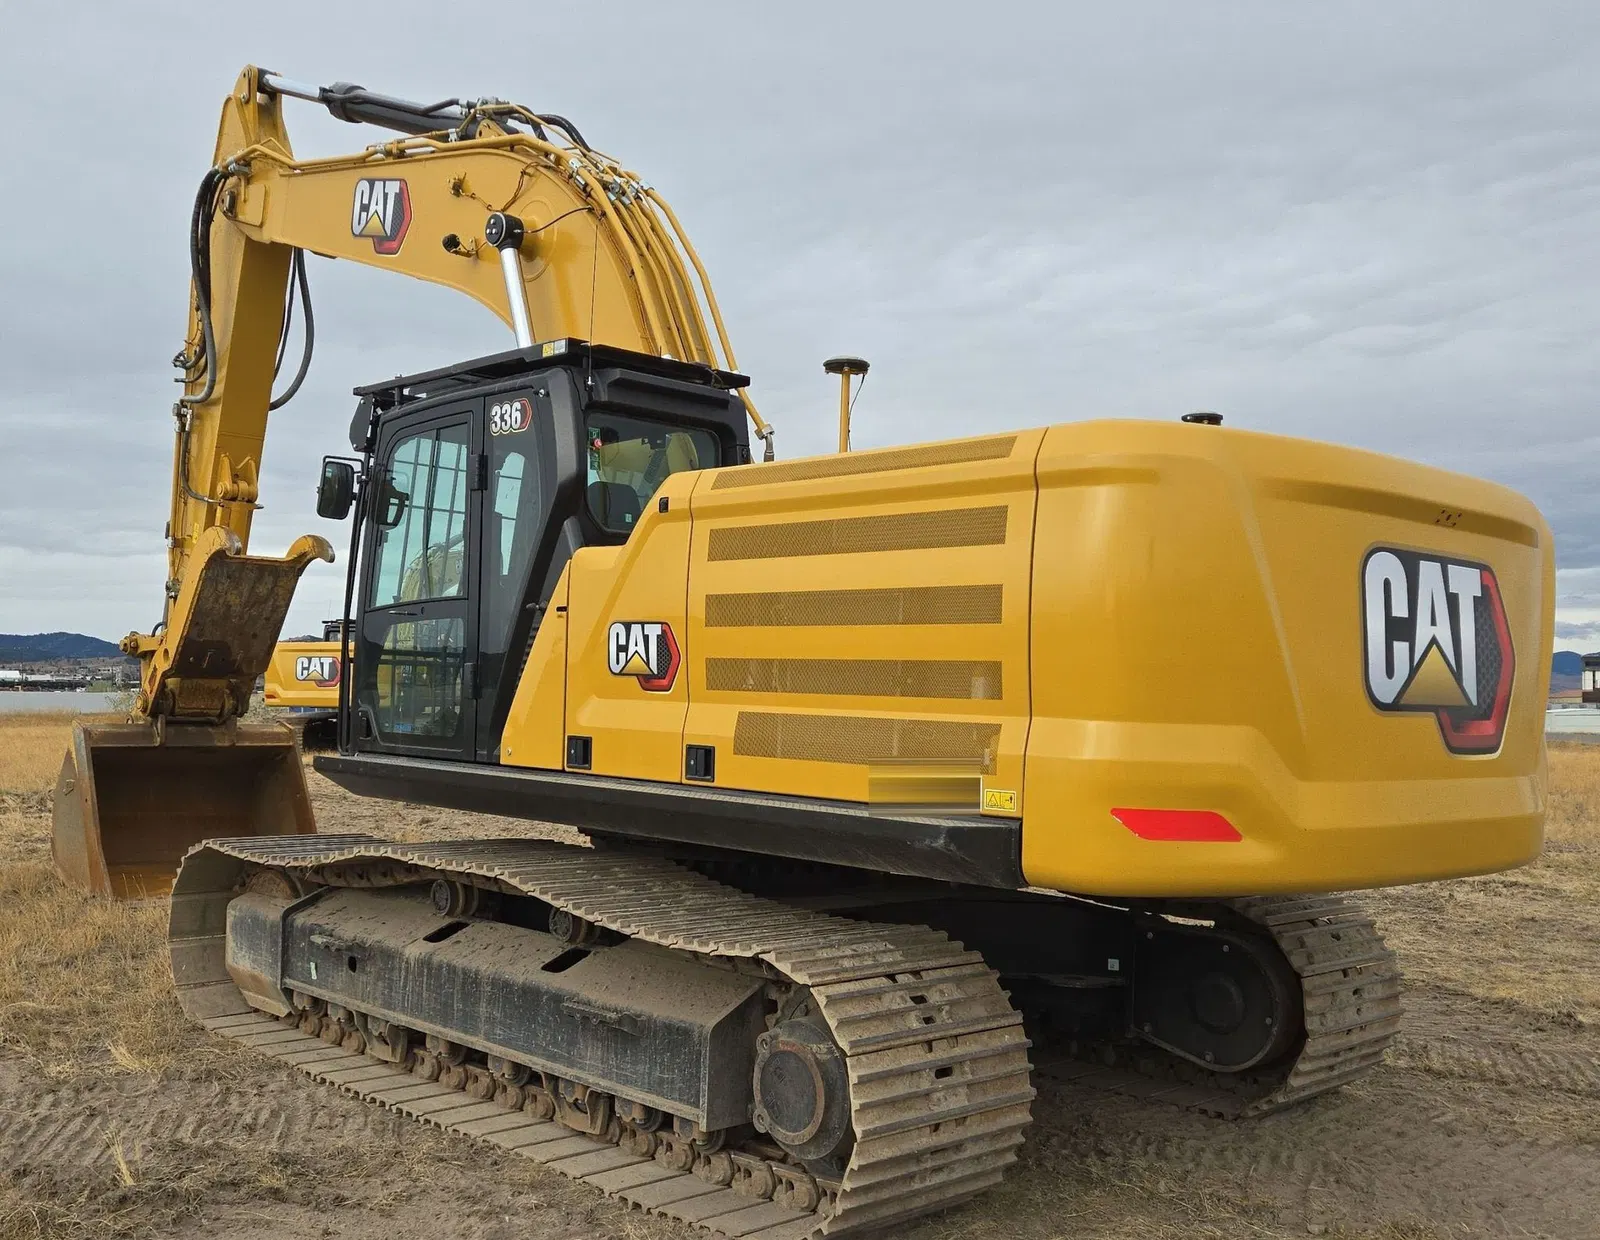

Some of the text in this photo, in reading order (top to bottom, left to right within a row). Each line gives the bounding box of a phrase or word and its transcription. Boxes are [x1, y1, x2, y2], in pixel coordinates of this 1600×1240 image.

[352, 179, 400, 236] CAT
[491, 401, 521, 432] 336
[609, 623, 662, 674] CAT
[1365, 551, 1482, 706] CAT
[296, 656, 333, 680] CAT
